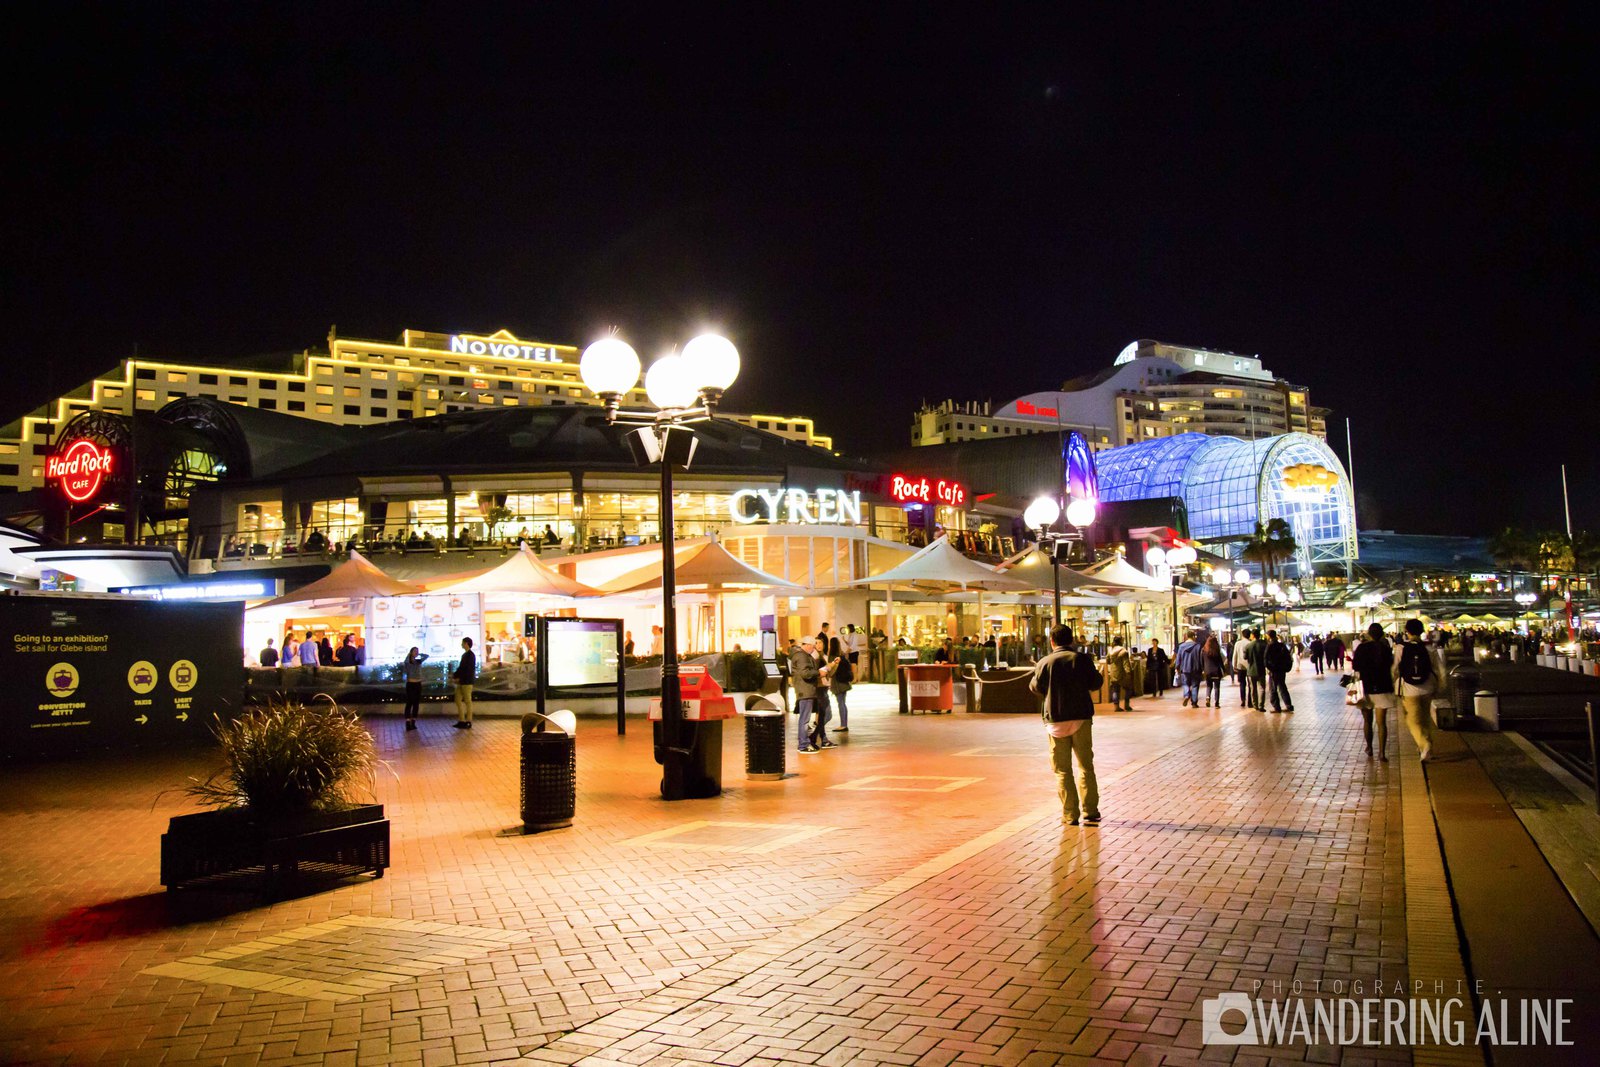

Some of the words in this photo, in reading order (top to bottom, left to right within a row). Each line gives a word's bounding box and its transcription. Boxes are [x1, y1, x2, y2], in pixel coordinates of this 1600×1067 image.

[451, 335, 563, 363] NOVOTEL
[48, 453, 79, 477] Hard
[81, 449, 111, 476] Rock
[72, 479, 89, 489] CAFE
[893, 476, 930, 502] Rock
[937, 480, 964, 505] Cafe
[729, 488, 861, 524] CYREN
[13, 634, 40, 645] Going
[42, 635, 51, 643] to
[65, 634, 109, 643] exhibition?
[15, 644, 28, 652] Set
[32, 644, 46, 652] sail
[48, 644, 59, 652] for
[60, 644, 83, 652] Glebe
